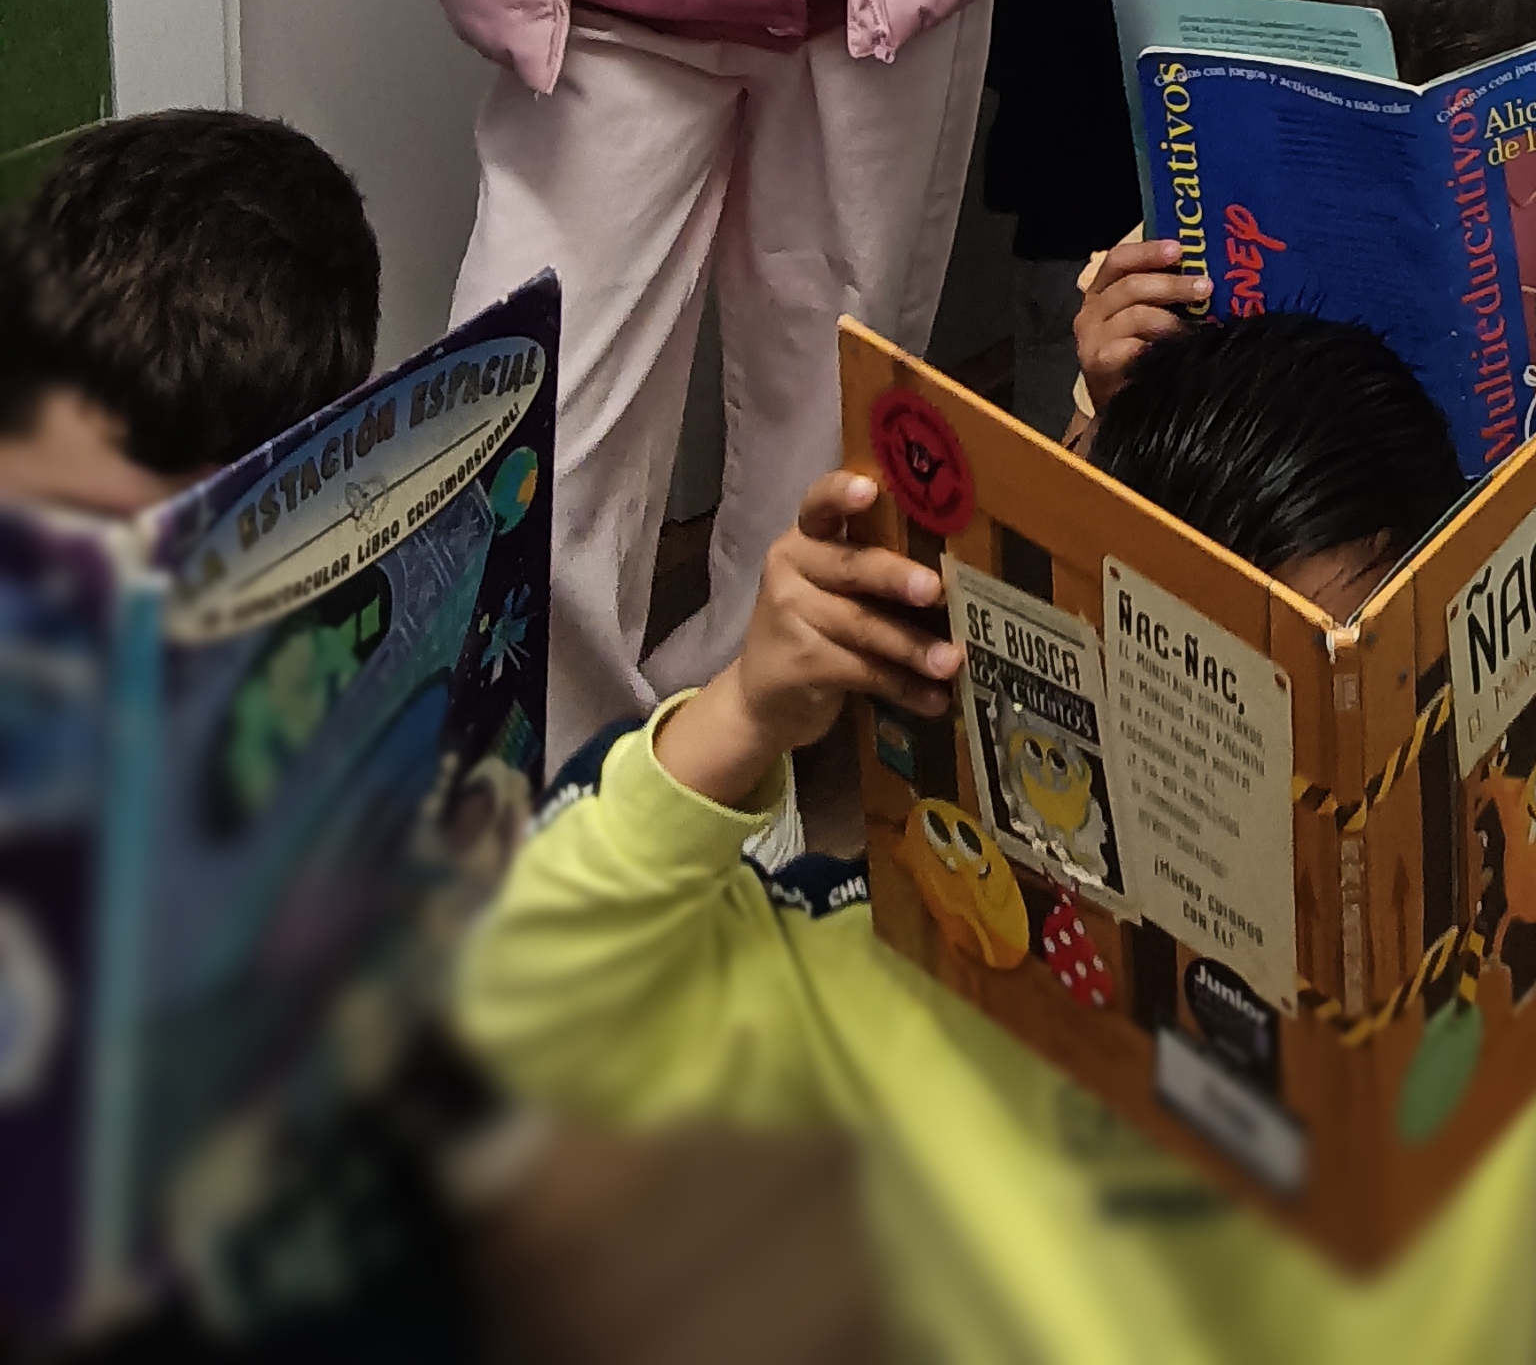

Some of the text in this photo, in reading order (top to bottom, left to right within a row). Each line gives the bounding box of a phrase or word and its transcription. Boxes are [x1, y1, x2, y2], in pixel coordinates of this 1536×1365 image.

[1487, 137, 1521, 167] de
[409, 346, 539, 429] ESPACIAL
[966, 600, 1082, 693] SE BUSCA
